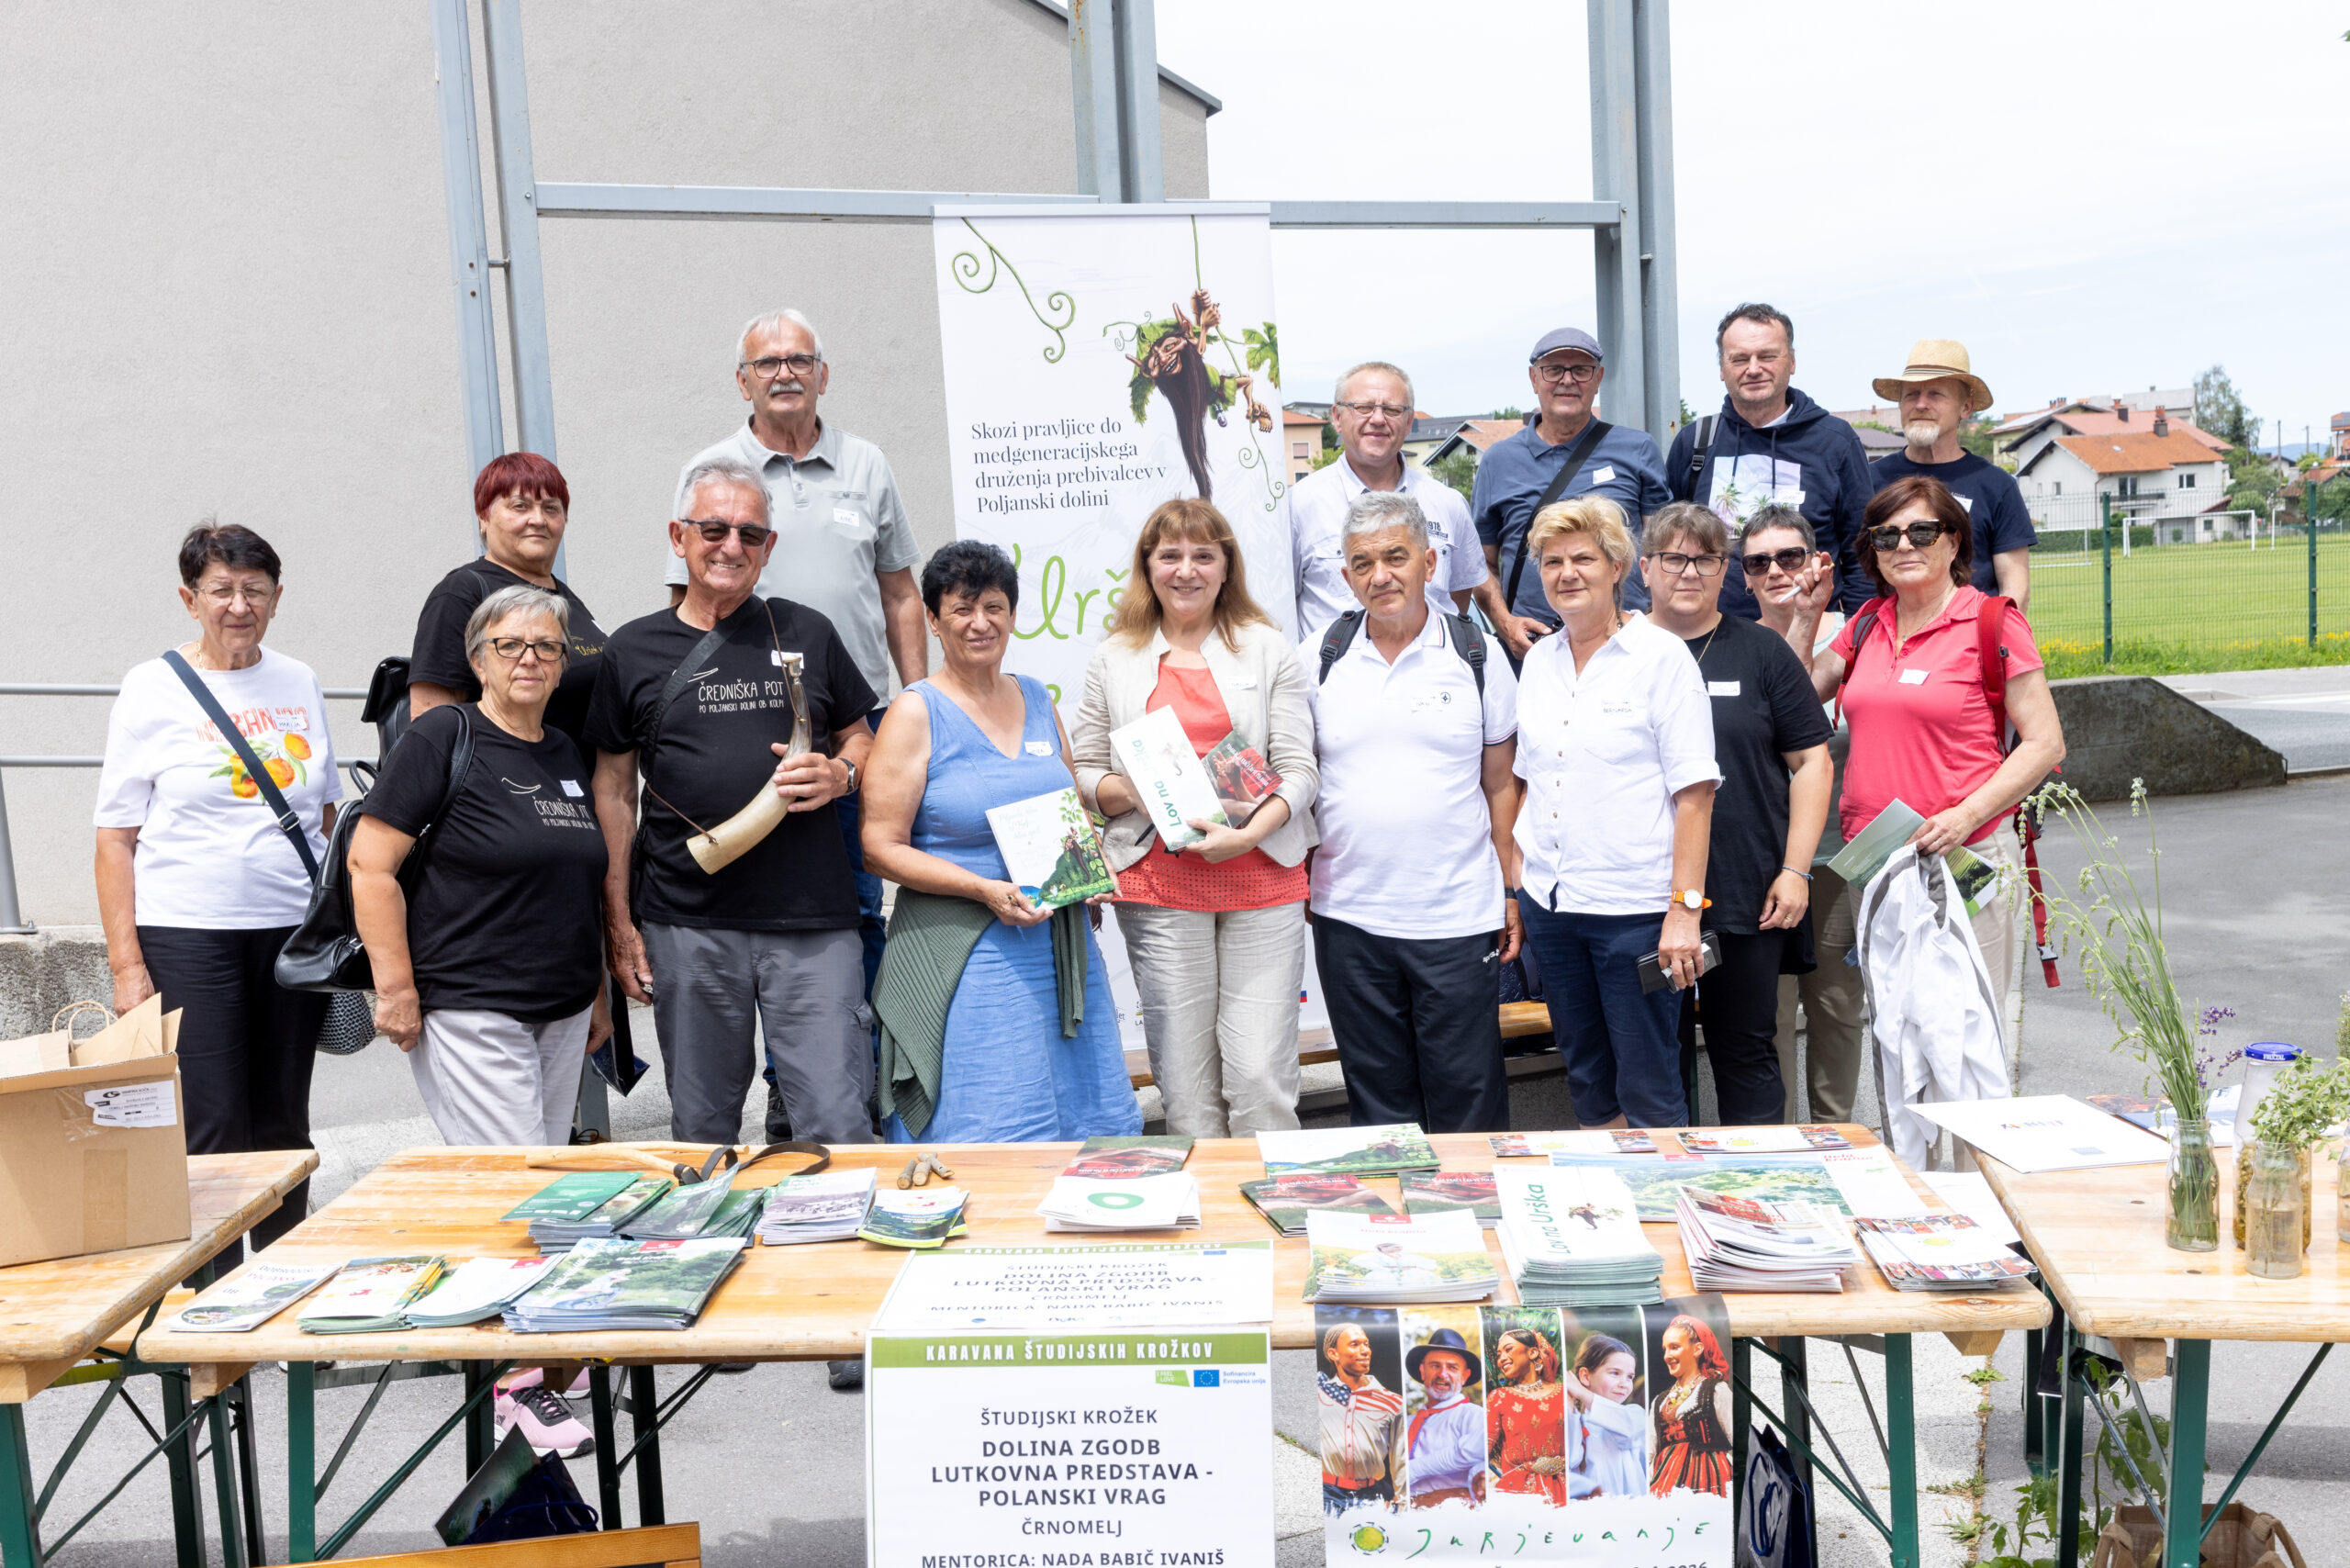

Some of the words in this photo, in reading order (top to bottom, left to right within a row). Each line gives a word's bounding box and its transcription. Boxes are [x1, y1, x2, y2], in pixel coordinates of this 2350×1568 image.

[971, 423, 1018, 440] Skozi
[1022, 420, 1095, 441] pravljice
[1101, 418, 1122, 434] do
[973, 442, 1138, 466] medgeneracijskega
[975, 466, 1051, 490] druženja
[1057, 464, 1153, 487] prebivalcev
[1157, 466, 1167, 478] v
[977, 492, 1056, 515] Poljanski
[1060, 488, 1110, 509] dolini
[698, 678, 758, 701] ČREDNIŠKA
[764, 680, 784, 696] POT
[699, 704, 707, 713] PO
[709, 702, 738, 713] POLJANSKI
[740, 700, 756, 711] DOLINI
[758, 700, 767, 708] OB
[769, 700, 784, 708] KOLPI
[1154, 780, 1173, 800] na
[532, 795, 579, 818] ČREDNIŠKA
[1164, 800, 1183, 827] Lov
[1524, 1184, 1553, 1223] Urška
[1540, 1226, 1562, 1238] na
[1546, 1238, 1571, 1254] Lov
[926, 1343, 1016, 1361] KARAVANA
[1024, 1339, 1127, 1361] ŠTUDIJSKIH
[1136, 1338, 1214, 1360] KROŽKOV
[980, 1407, 1077, 1428] ŠTUDIJSKI
[1083, 1406, 1158, 1425] KROŽEK
[981, 1439, 1074, 1458] DOLINA
[1080, 1438, 1161, 1456] ZGODB
[931, 1464, 1058, 1484] LUTKOVNA
[1066, 1462, 1200, 1482] PREDSTAVA
[979, 1488, 1098, 1506] POLANSKI
[1103, 1487, 1167, 1506] VRAG
[1021, 1517, 1123, 1538] ČRNOMELJ
[921, 1553, 1036, 1568] MENTORICA:
[1042, 1551, 1094, 1567] NADA
[1100, 1549, 1155, 1566] BABIČ
[1160, 1548, 1225, 1566] IVANIŠ
